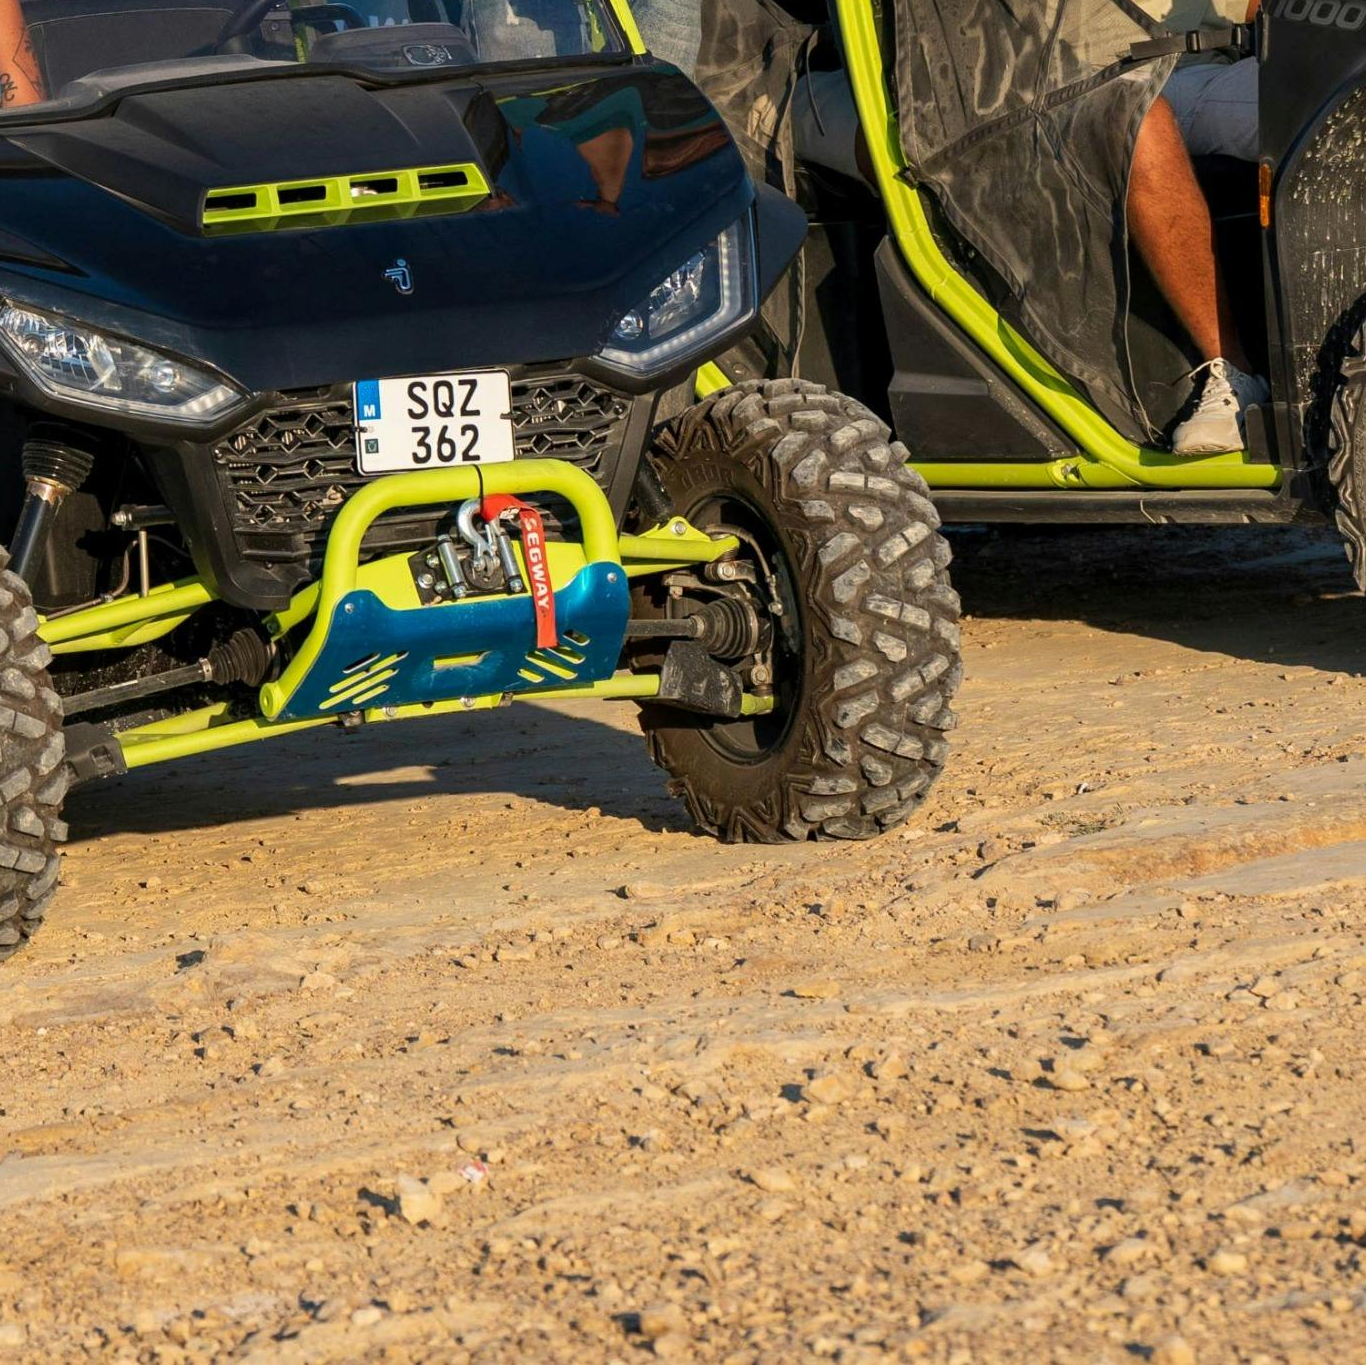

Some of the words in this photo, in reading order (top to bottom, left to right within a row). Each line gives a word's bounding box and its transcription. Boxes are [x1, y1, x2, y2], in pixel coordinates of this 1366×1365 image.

[363, 404, 376, 417] M
[407, 378, 481, 419] SQZ
[411, 424, 481, 464] 362
[524, 517, 550, 609] SEGWAY
